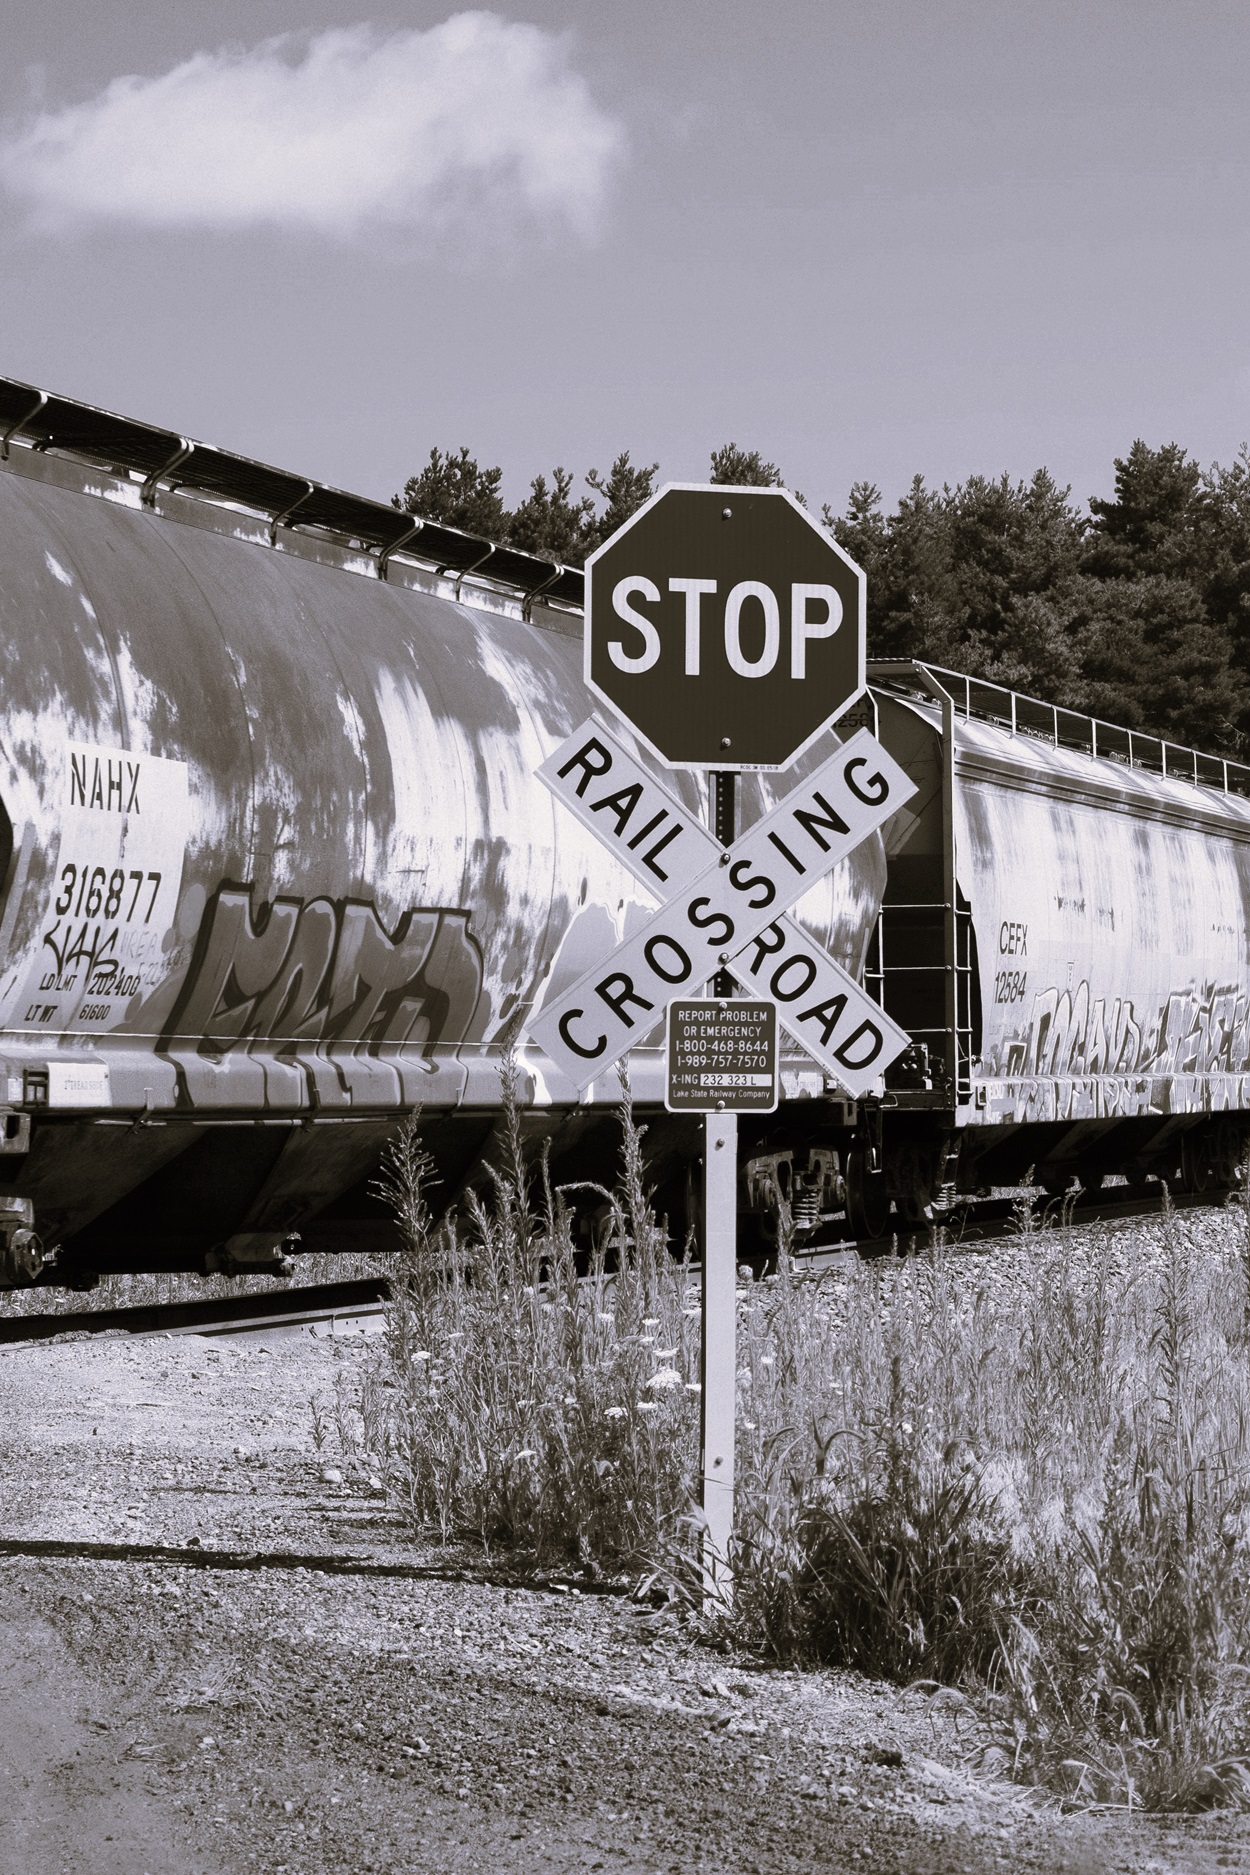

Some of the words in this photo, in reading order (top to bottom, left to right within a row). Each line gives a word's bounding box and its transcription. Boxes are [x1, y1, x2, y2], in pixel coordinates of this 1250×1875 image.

[607, 576, 844, 680] STOP
[71, 753, 141, 814] NAHX
[55, 864, 162, 923] 316877
[556, 737, 684, 882] RAIL
[750, 921, 884, 1071] ROAD
[558, 757, 890, 1059] CROSSING
[999, 921, 1028, 956] CEFX
[39, 973, 56, 991] LD
[56, 974, 78, 992] LMT
[87, 974, 142, 997] 202400
[995, 971, 1028, 1004] 12584
[24, 1005, 42, 1021] LT
[39, 1006, 59, 1022] WT
[79, 1004, 111, 1020] 61600
[678, 1010, 716, 1021] REPORT
[720, 1011, 768, 1022] PROBLEM
[683, 1026, 697, 1036] OR
[700, 1026, 762, 1037] EMERGENCY
[675, 1040, 769, 1052] 1-800-468-8644
[677, 1055, 767, 1067] 1-989-757-7570
[671, 1074, 698, 1085] X-ING
[703, 1075, 723, 1085] 232
[727, 1075, 748, 1085] 323
[750, 1076, 757, 1085] L
[673, 1090, 689, 1098] Lake
[690, 1089, 708, 1098] State
[709, 1089, 737, 1100] Railway
[738, 1089, 770, 1100] Company
